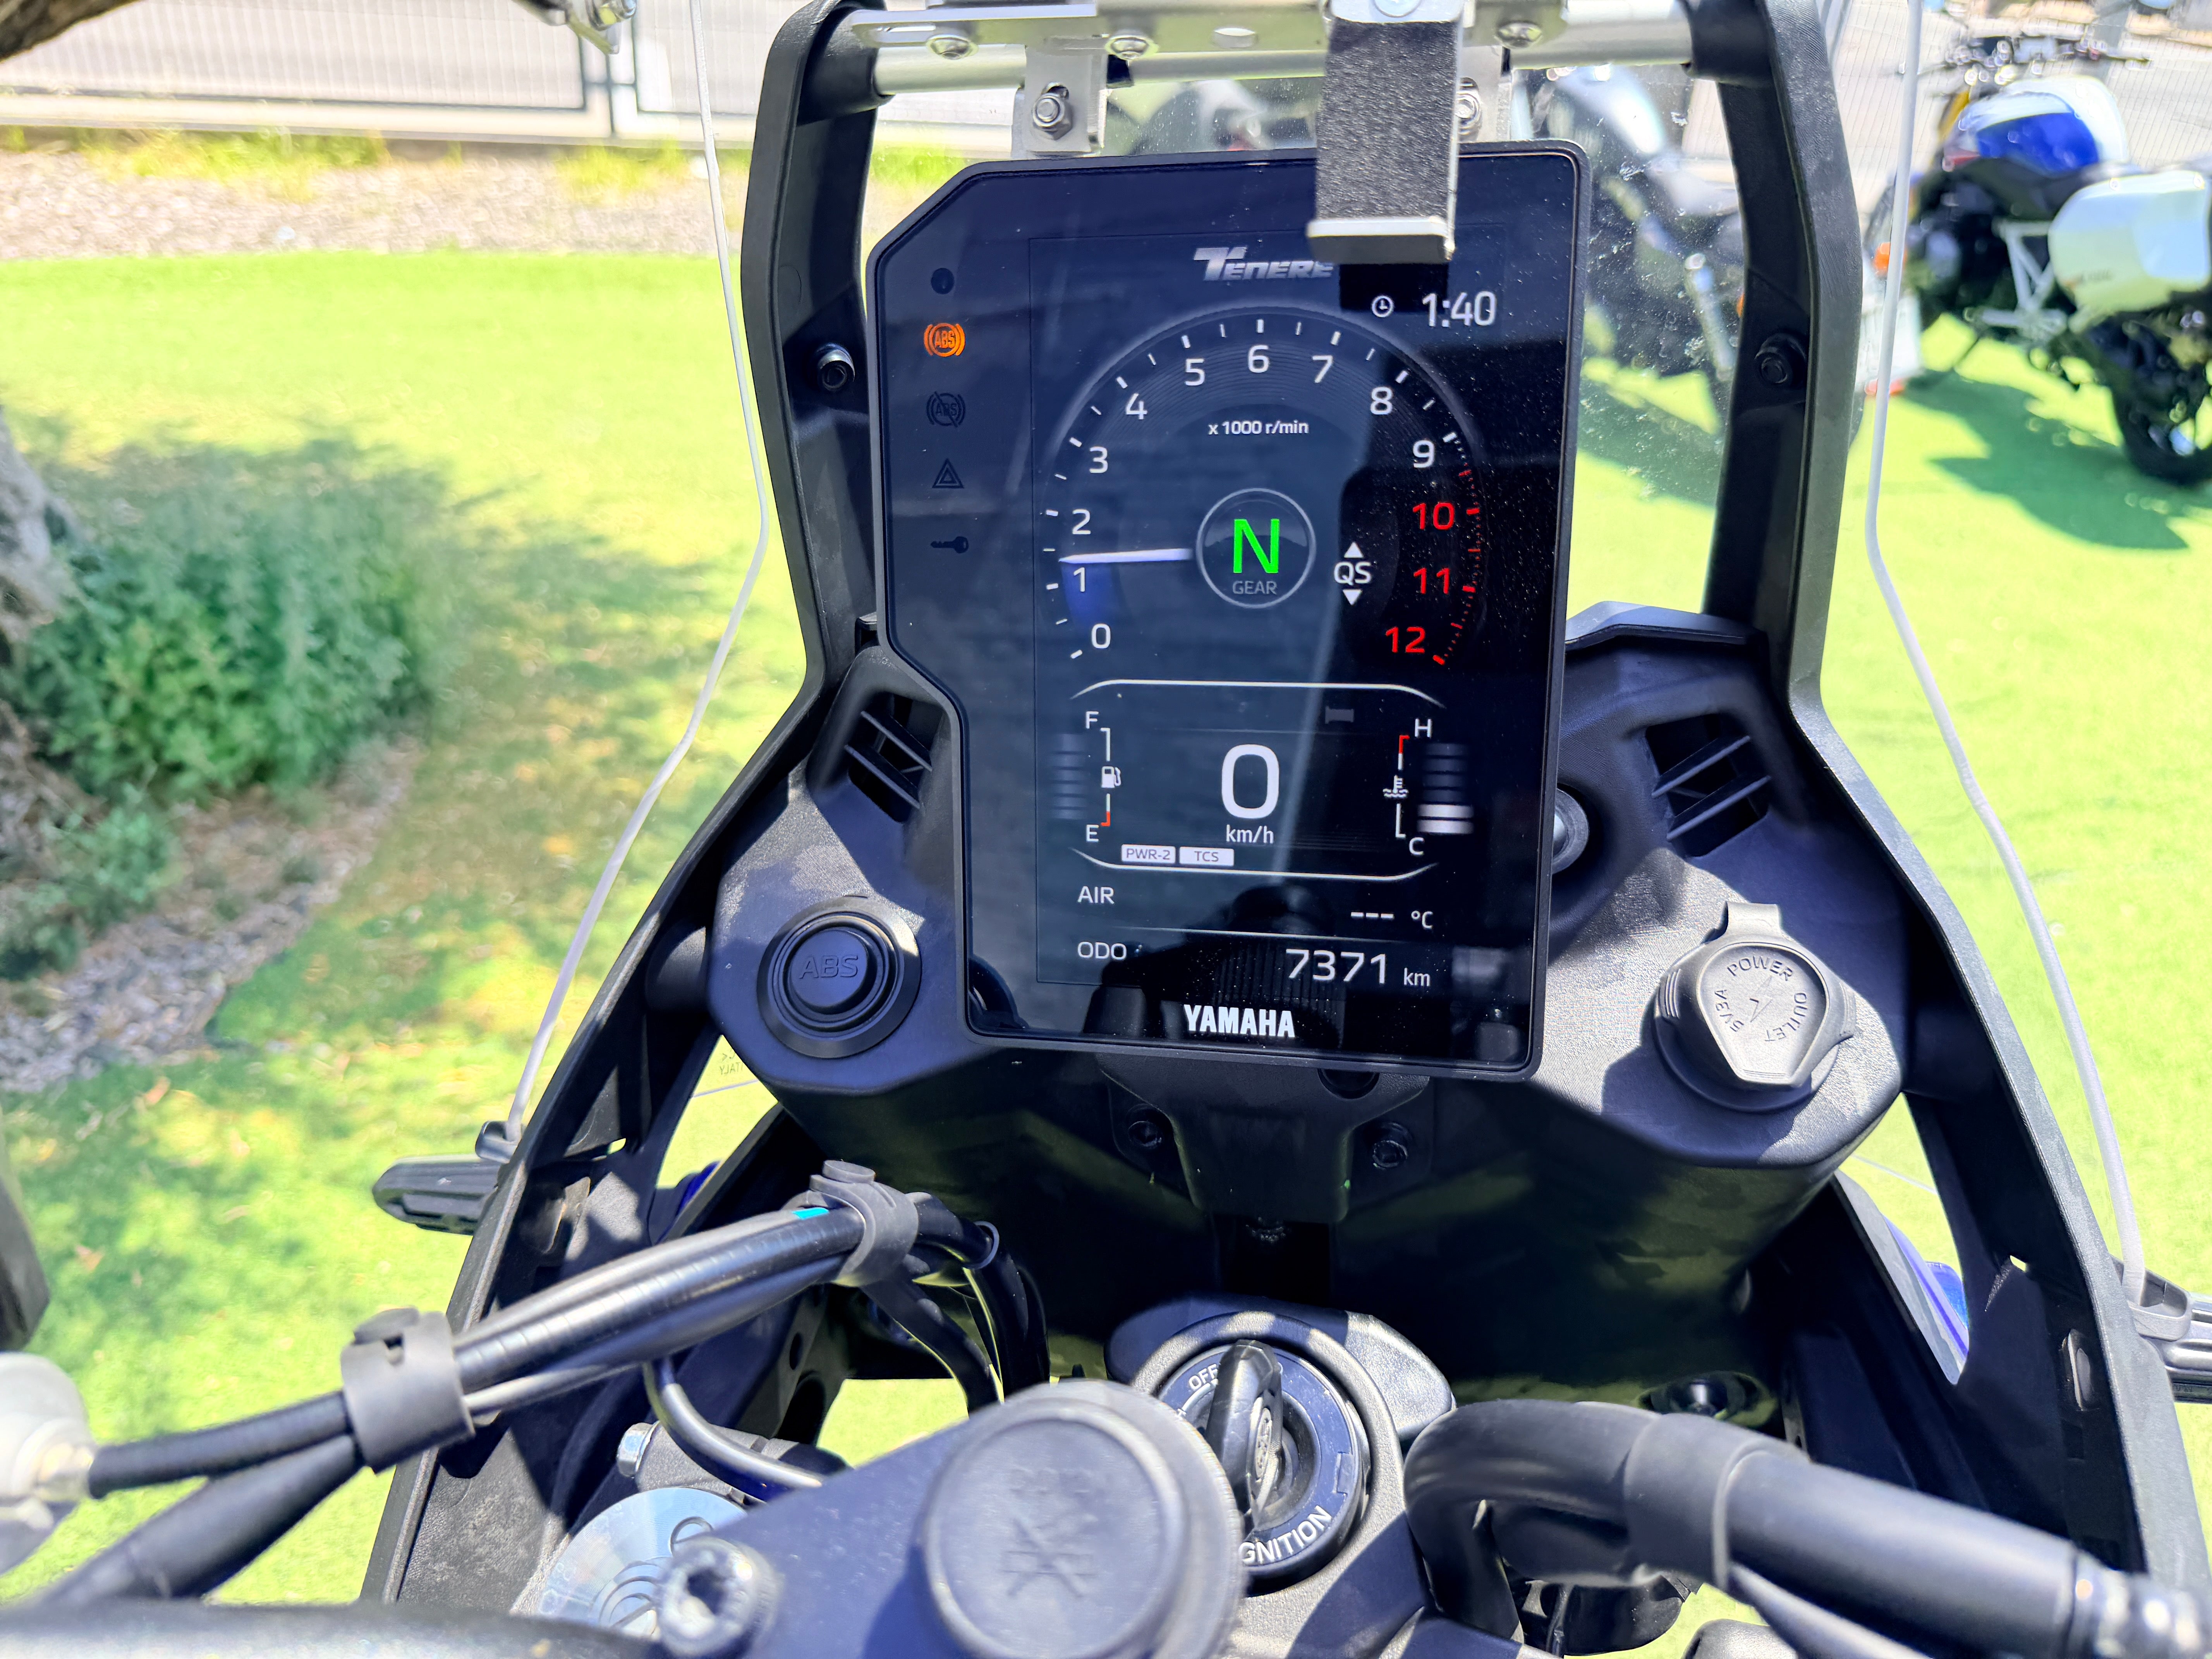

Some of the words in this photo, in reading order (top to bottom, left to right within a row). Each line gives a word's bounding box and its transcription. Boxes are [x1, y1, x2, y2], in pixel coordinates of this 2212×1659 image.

[1422, 291, 1496, 327] 1:40
[935, 330, 955, 349] ABS
[1185, 358, 1205, 386] 5
[1248, 345, 1269, 373] 6
[1312, 355, 1333, 383] 7
[1126, 393, 1148, 420] 4
[1370, 386, 1393, 415] 8
[1208, 424, 1218, 435] x
[1222, 421, 1262, 434] 1000
[1266, 420, 1309, 434] r/min
[1089, 447, 1108, 473] 3
[1413, 440, 1434, 468] 9
[1072, 509, 1091, 535] 2
[1412, 501, 1455, 530] 10
[1233, 519, 1279, 574] N
[1073, 567, 1085, 592] 1
[1232, 580, 1277, 594] GEAR
[1333, 562, 1371, 586] QS
[1413, 567, 1449, 594] 11
[1091, 623, 1111, 649] 0
[1386, 627, 1425, 653] 12
[1085, 711, 1099, 729] F
[1415, 718, 1432, 738] H
[1221, 744, 1279, 819] 0
[1086, 824, 1099, 842] E
[1226, 824, 1274, 844] km/h
[1409, 837, 1424, 855] C
[1125, 848, 1171, 861] PWR-2
[1194, 851, 1219, 862] TCS
[1077, 886, 1115, 904] AIR
[1077, 941, 1127, 960] ODO
[799, 955, 859, 979] ABS
[1286, 948, 1386, 984] 7371
[1404, 967, 1430, 987] km
[1727, 956, 1793, 981] POWER
[1764, 992, 1808, 1042] OUTLET
[1183, 1004, 1295, 1038] YAMAHA
[1188, 1363, 1218, 1391] OFF
[1239, 1505, 1331, 1563] GNITION
